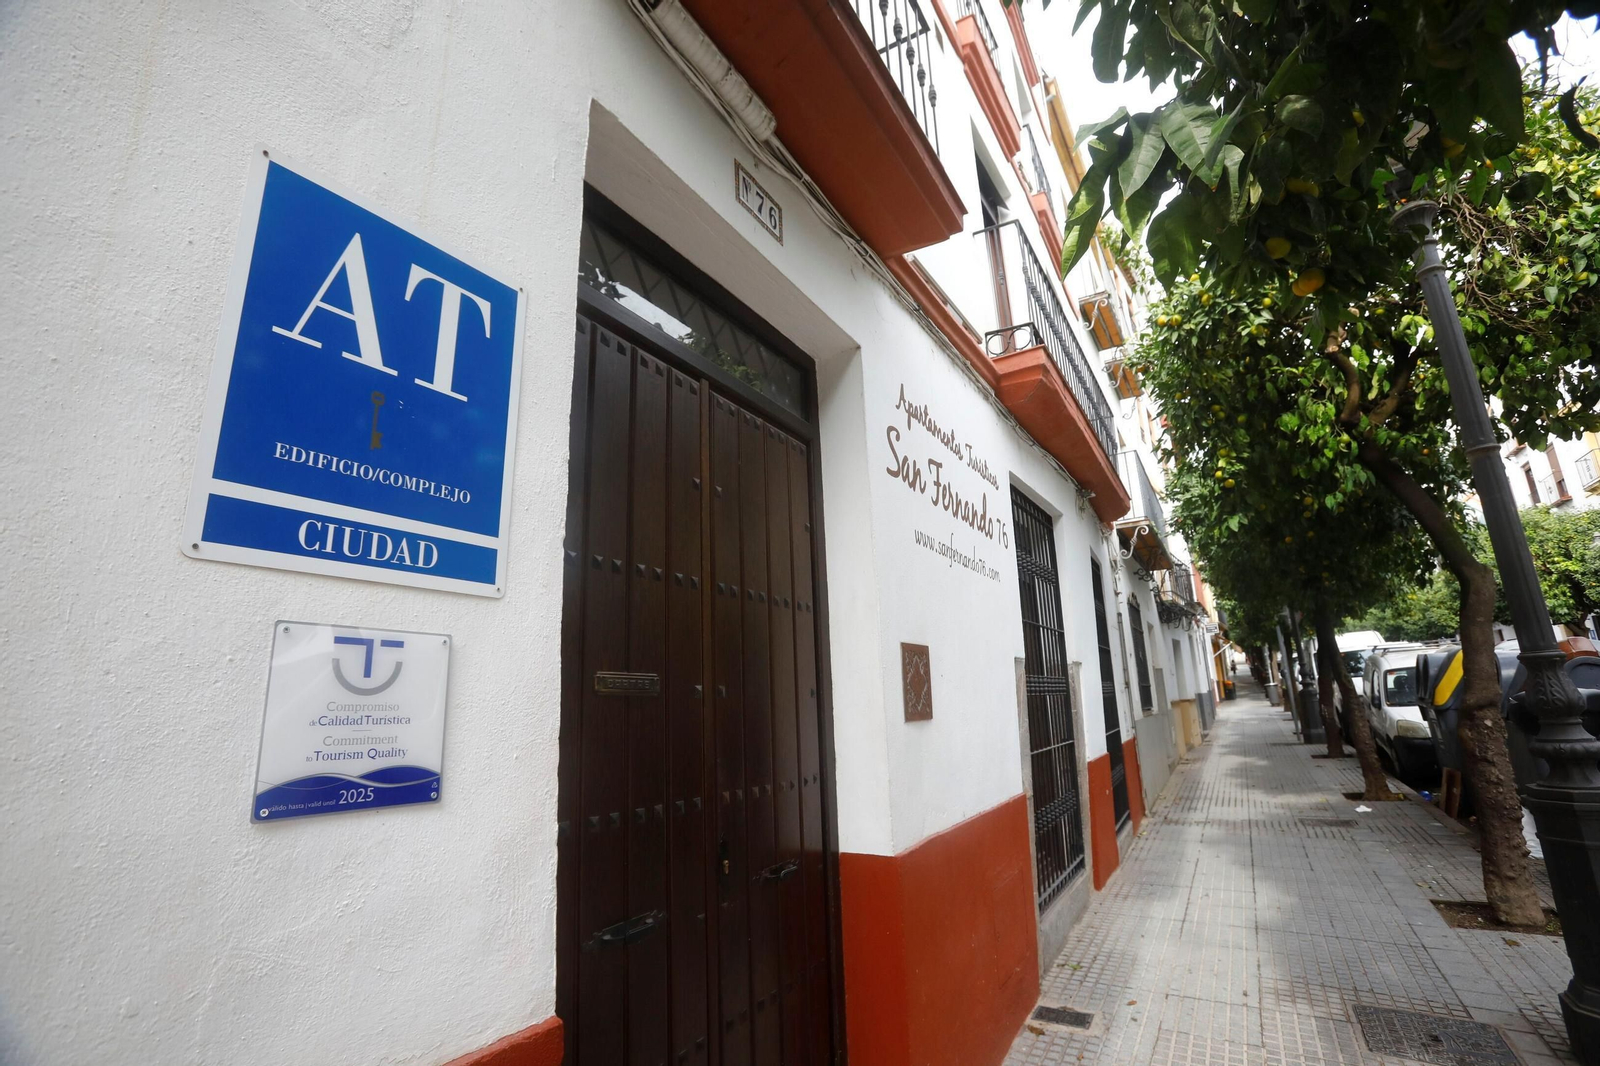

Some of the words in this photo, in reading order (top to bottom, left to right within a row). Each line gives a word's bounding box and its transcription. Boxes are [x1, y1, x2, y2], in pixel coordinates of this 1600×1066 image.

[756, 190, 777, 230] 76
[272, 232, 491, 402] AT
[895, 383, 963, 461] Apartamentos
[274, 441, 471, 504] EDIFICIO/COMPLEJO
[886, 425, 926, 494] San
[928, 458, 993, 540] Fernando
[996, 518, 1009, 550] 76
[298, 519, 439, 569] CIUDAD
[914, 529, 1000, 582] www.sanfernando76.com
[309, 719, 318, 727] de
[318, 715, 363, 726] Calidad
[364, 714, 411, 725] Turística
[326, 701, 399, 714] Compromiso
[314, 750, 364, 761] Tourism
[367, 747, 408, 760] Quality
[323, 735, 399, 747] Commitment
[338, 787, 375, 804] 2025
